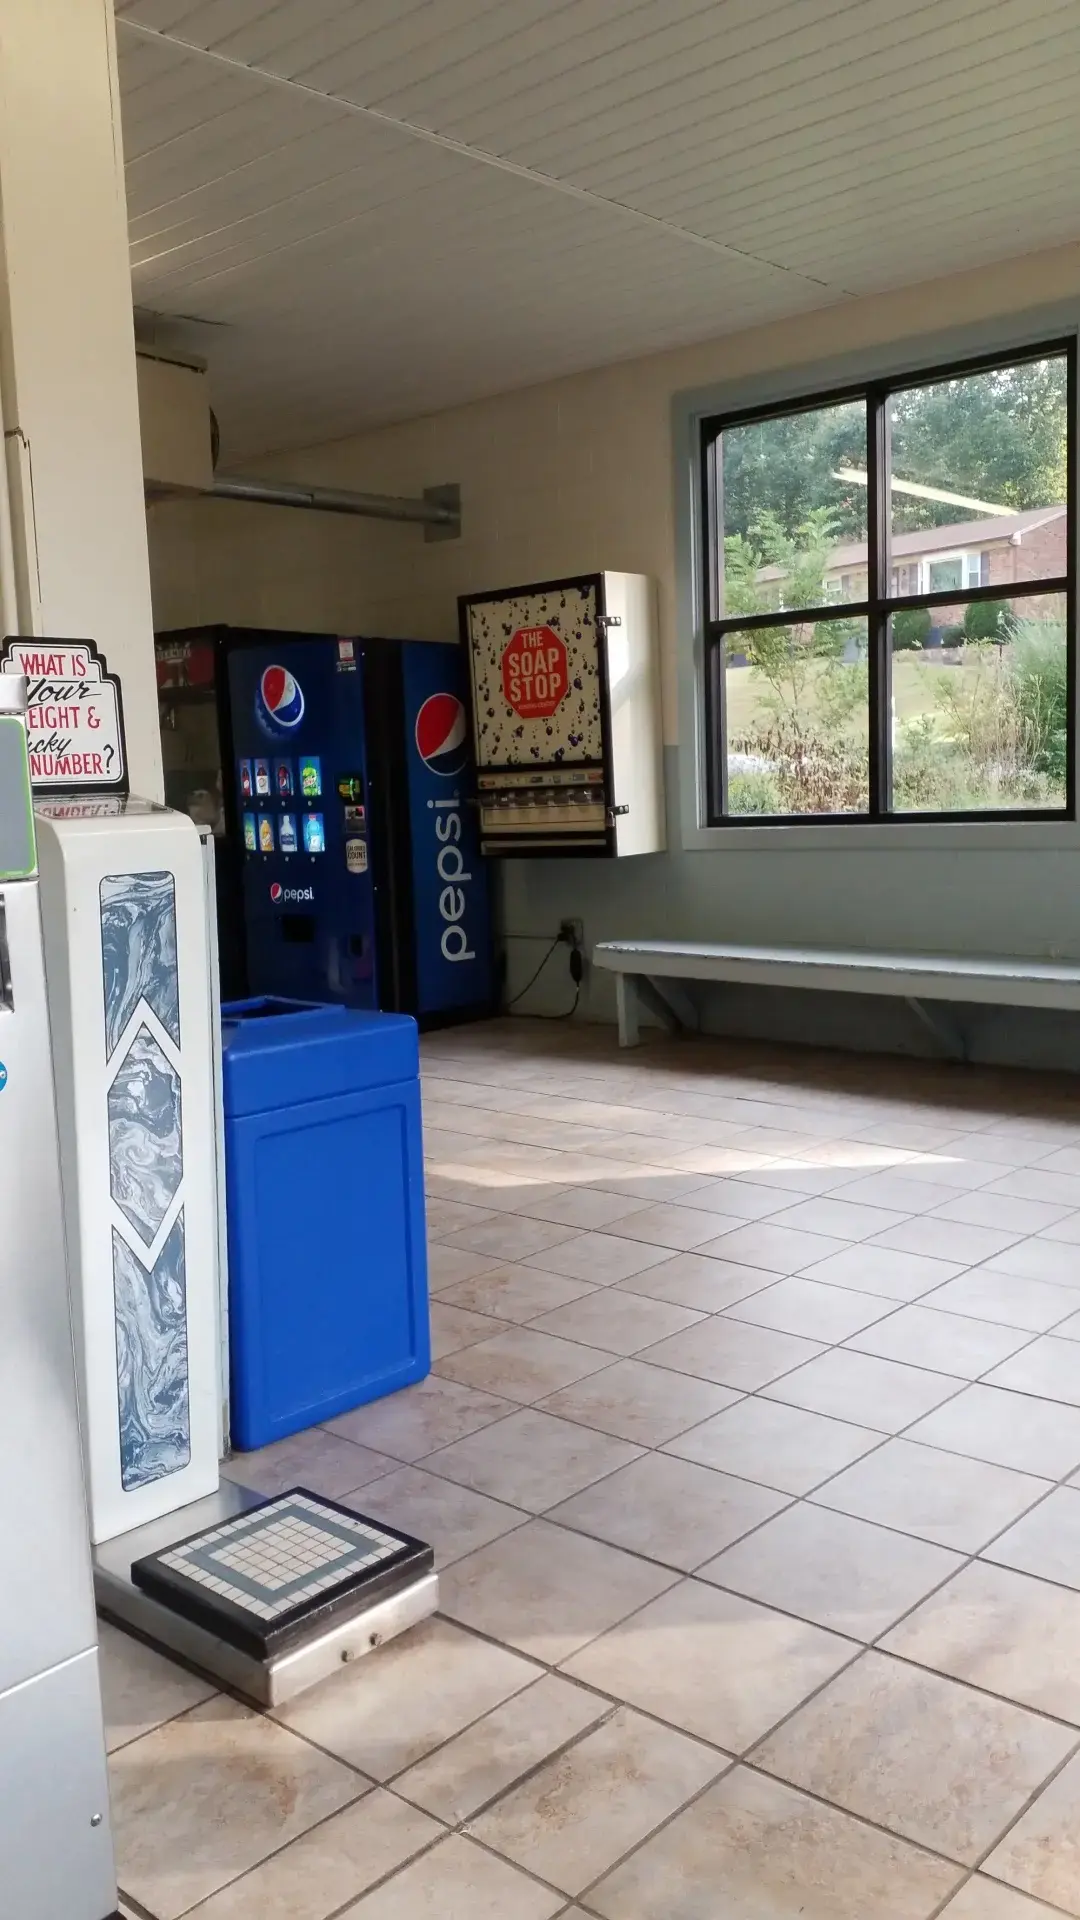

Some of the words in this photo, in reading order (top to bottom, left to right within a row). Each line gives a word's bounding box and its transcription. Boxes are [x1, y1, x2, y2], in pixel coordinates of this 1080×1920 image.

[521, 631, 543, 648] THE
[20, 654, 66, 675] WHAT
[71, 655, 86, 676] IS
[509, 648, 559, 677] SOAP
[510, 673, 561, 702] STOP
[28, 706, 80, 729] EIGHT
[87, 706, 101, 729] &
[427, 800, 476, 962] pepsi
[284, 886, 315, 902] pepsi
